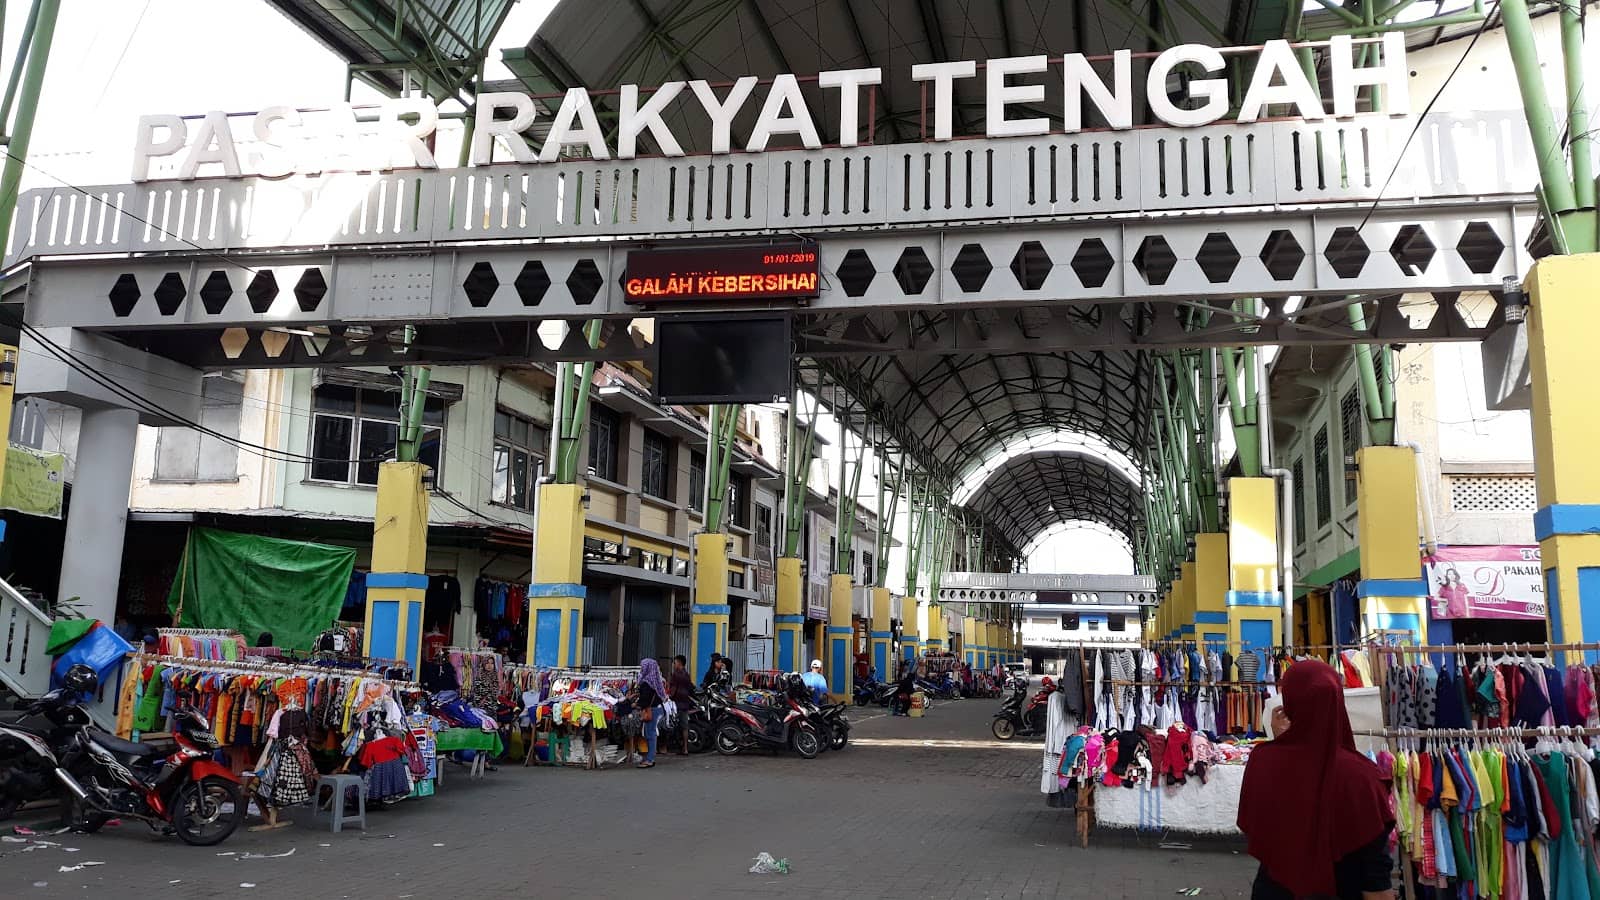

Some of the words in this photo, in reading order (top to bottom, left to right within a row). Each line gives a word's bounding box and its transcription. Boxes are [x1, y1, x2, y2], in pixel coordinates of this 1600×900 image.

[473, 67, 883, 166] RAKYAT
[911, 31, 1410, 142] TENGAH
[763, 253, 815, 264] 01/01/2019
[627, 276, 693, 296] GALAH
